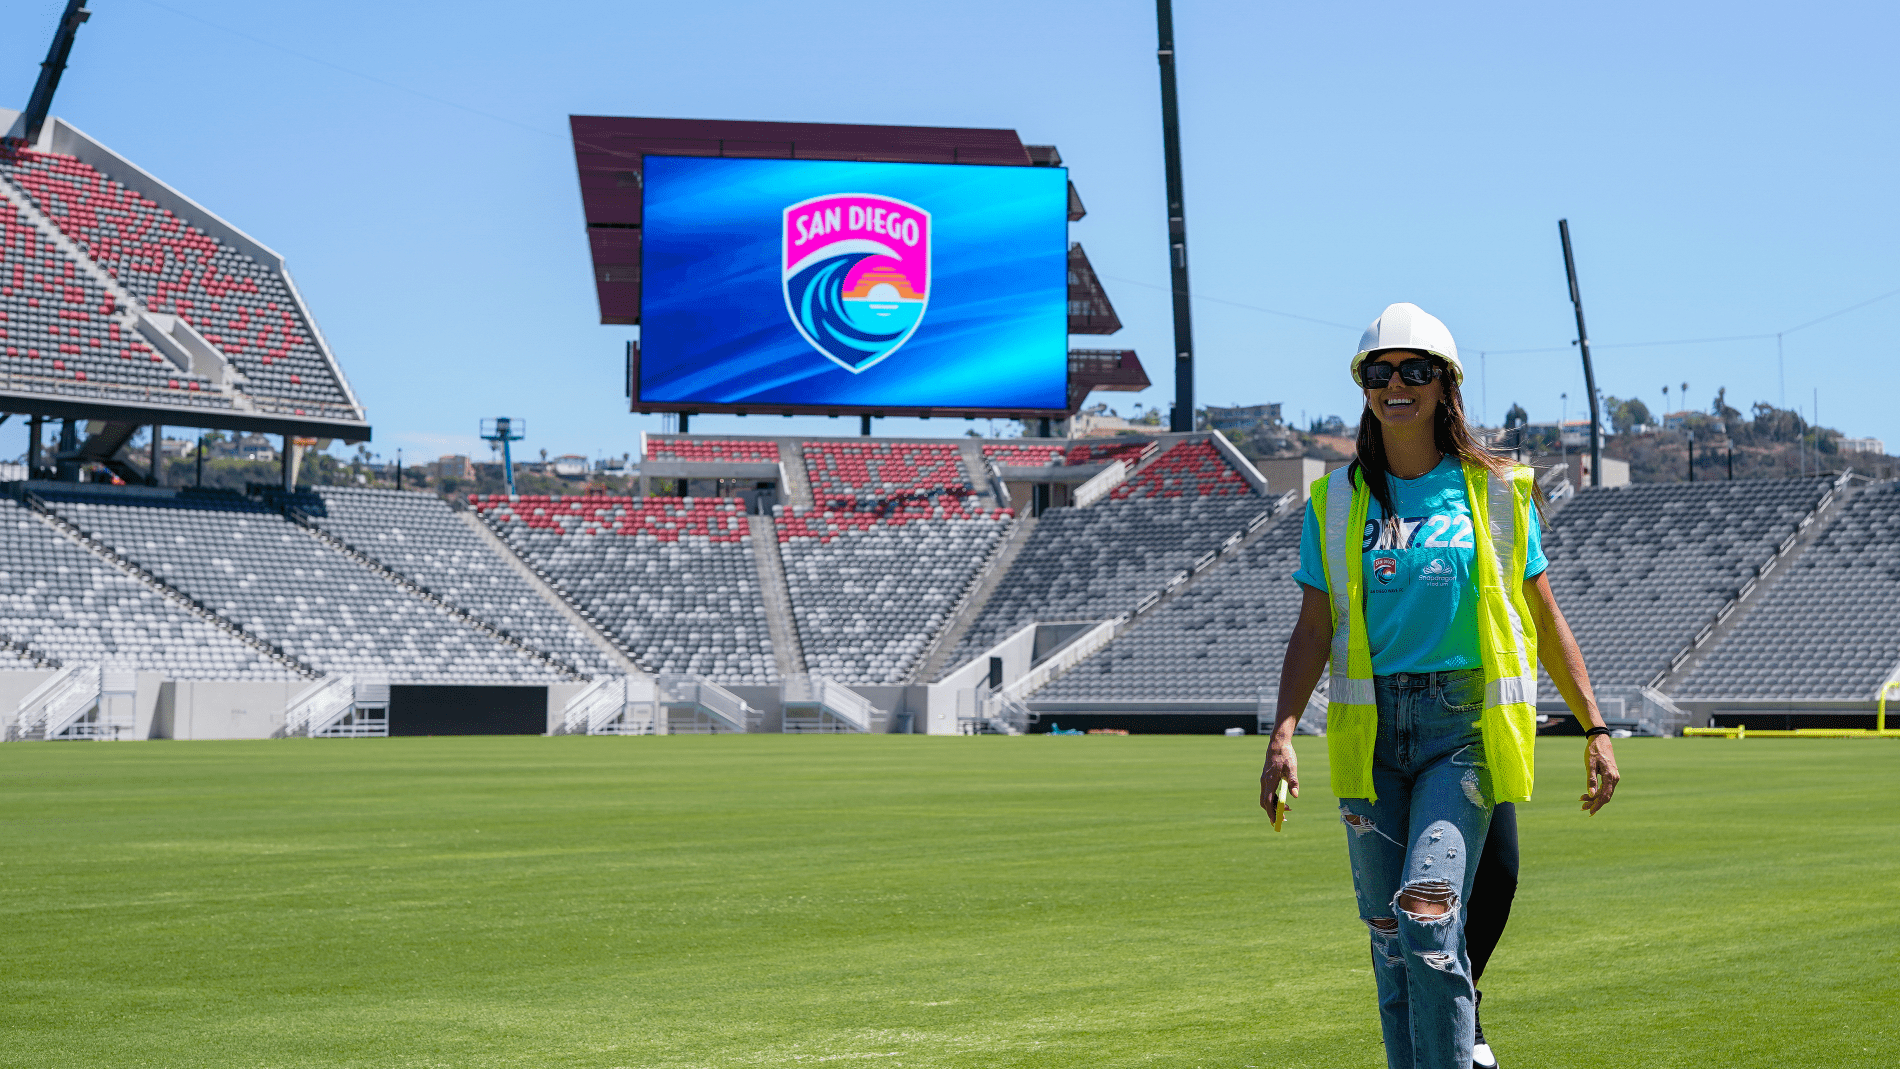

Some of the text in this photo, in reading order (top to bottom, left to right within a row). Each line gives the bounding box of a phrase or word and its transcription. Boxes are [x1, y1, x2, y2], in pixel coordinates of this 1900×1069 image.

[794, 205, 920, 247] SAN DIEGO
[1418, 574, 1457, 583] Snapdragon
